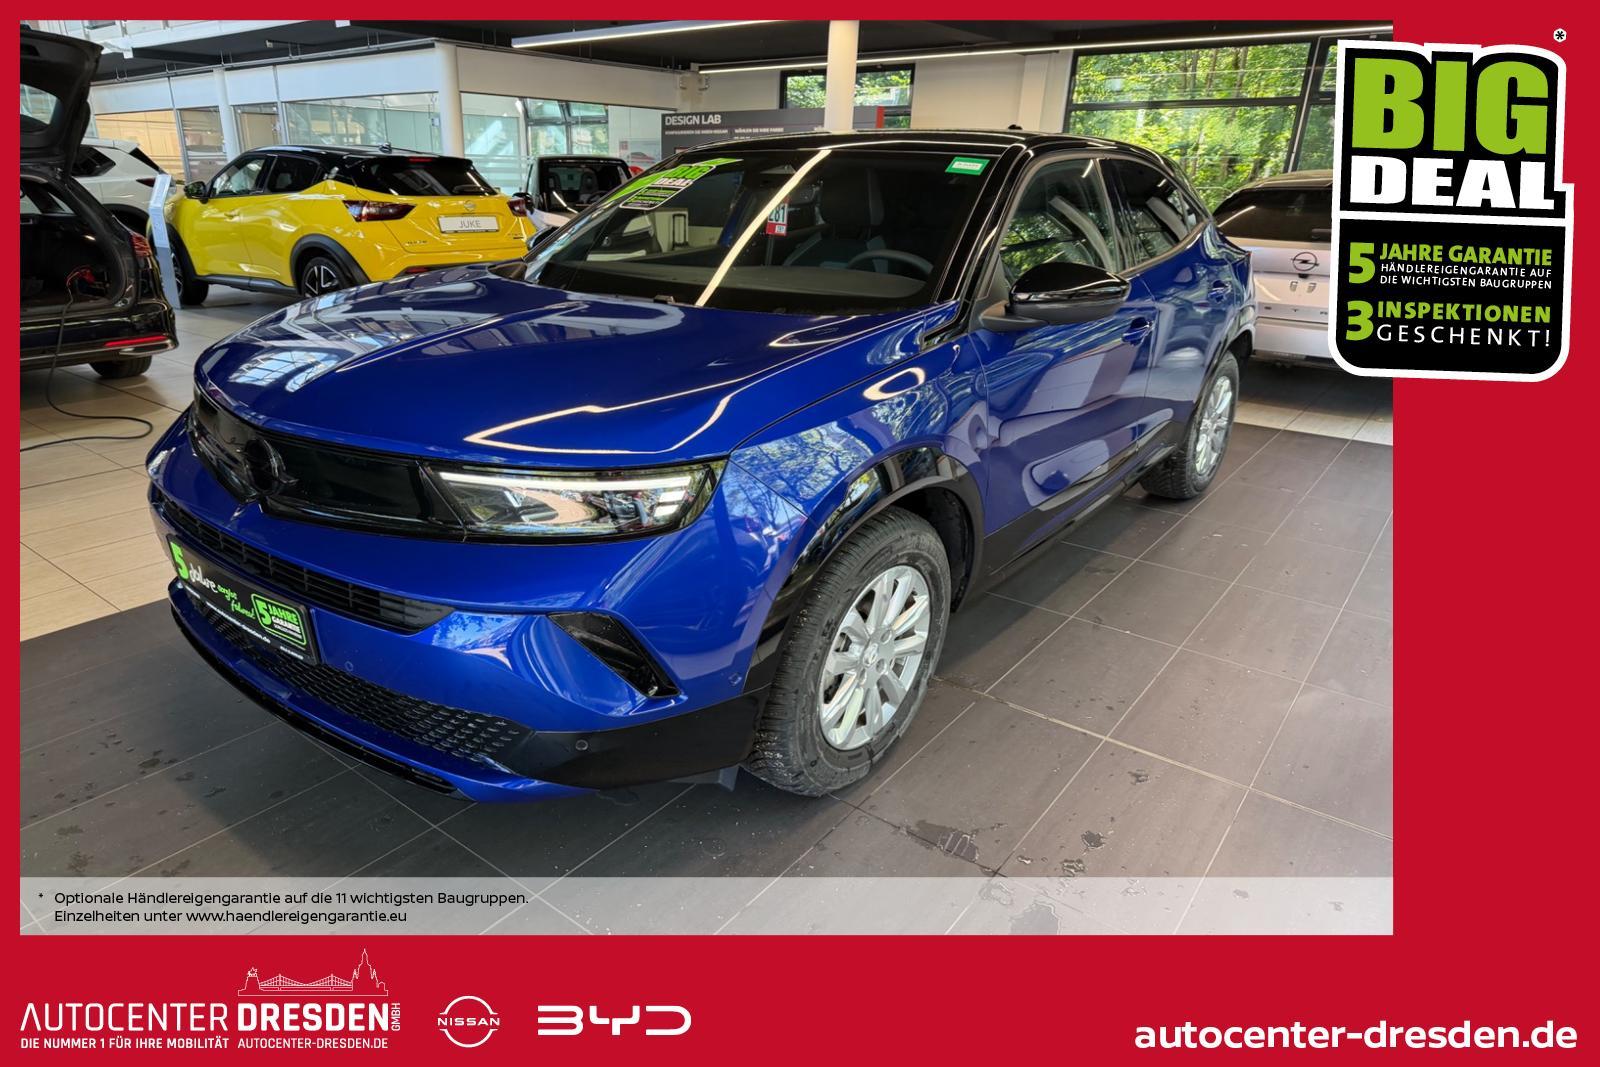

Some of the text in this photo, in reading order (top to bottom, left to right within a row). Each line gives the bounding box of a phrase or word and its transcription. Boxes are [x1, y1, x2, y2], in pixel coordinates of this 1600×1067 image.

[665, 114, 722, 126] DESIGN LAB
[459, 220, 482, 229] JUKE
[170, 541, 189, 580] 5
[255, 599, 272, 626] 5
[268, 603, 299, 626] JAHRE
